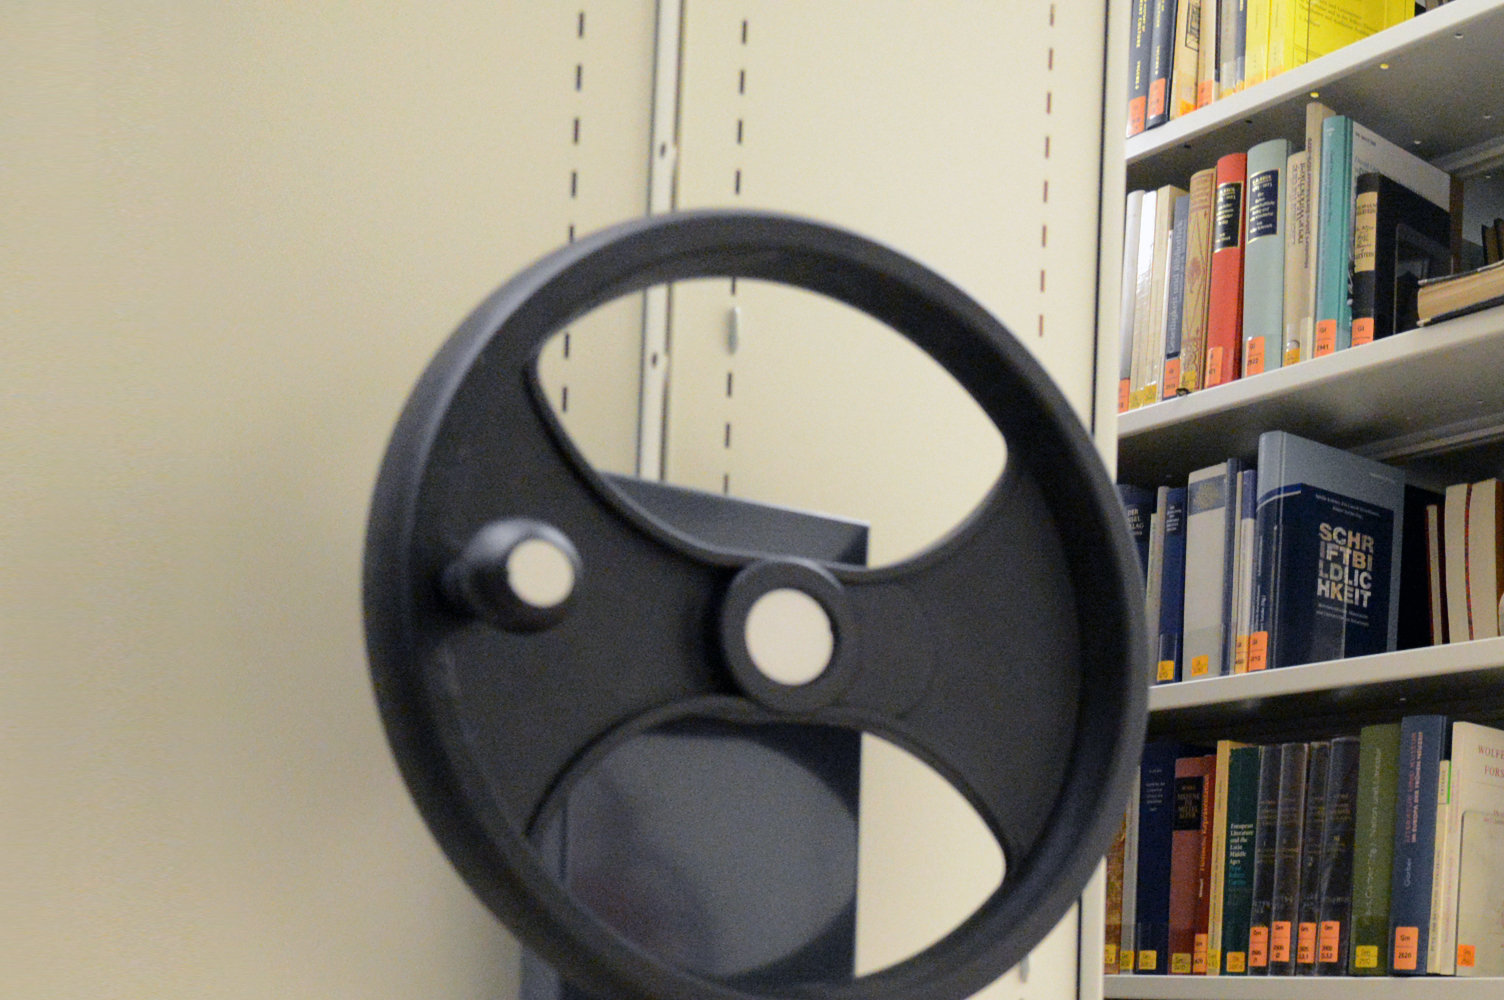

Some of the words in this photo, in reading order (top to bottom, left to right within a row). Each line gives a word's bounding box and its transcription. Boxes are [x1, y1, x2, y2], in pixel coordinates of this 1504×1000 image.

[1319, 522, 1374, 553] SCHR
[1319, 540, 1374, 572] IFTBI
[1318, 559, 1372, 590] LDLIC
[1317, 578, 1372, 608] HKEIT
[1230, 822, 1254, 830] European
[1404, 858, 1412, 888] Garber
